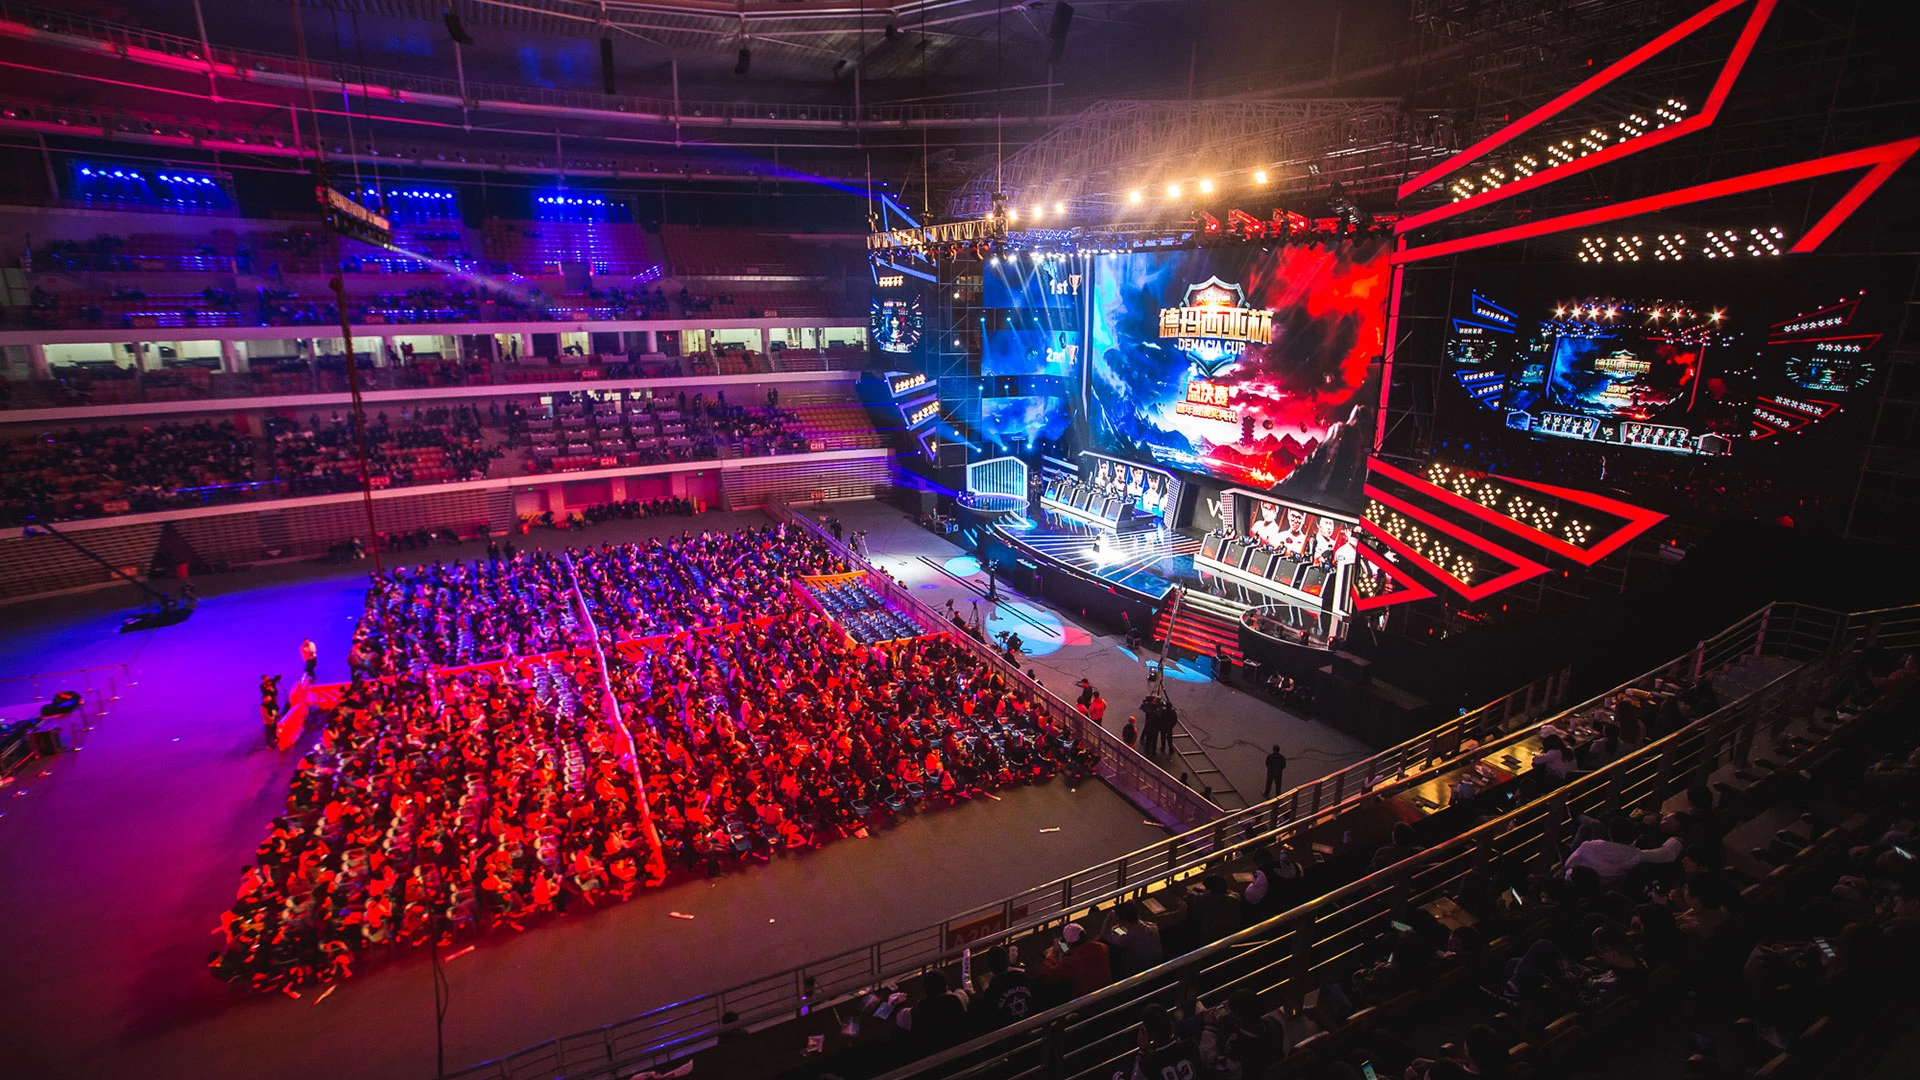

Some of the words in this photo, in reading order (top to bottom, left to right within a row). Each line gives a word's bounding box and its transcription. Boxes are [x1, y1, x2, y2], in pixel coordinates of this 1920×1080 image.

[1050, 279, 1068, 295] 1st
[1159, 307, 1274, 345] 德玛西亚杯
[1178, 338, 1222, 351] DEMACIA
[1224, 341, 1246, 355] CUP
[1046, 348, 1065, 363] 2nd
[1187, 382, 1229, 406] 总决赛
[600, 456, 617, 466] C214
